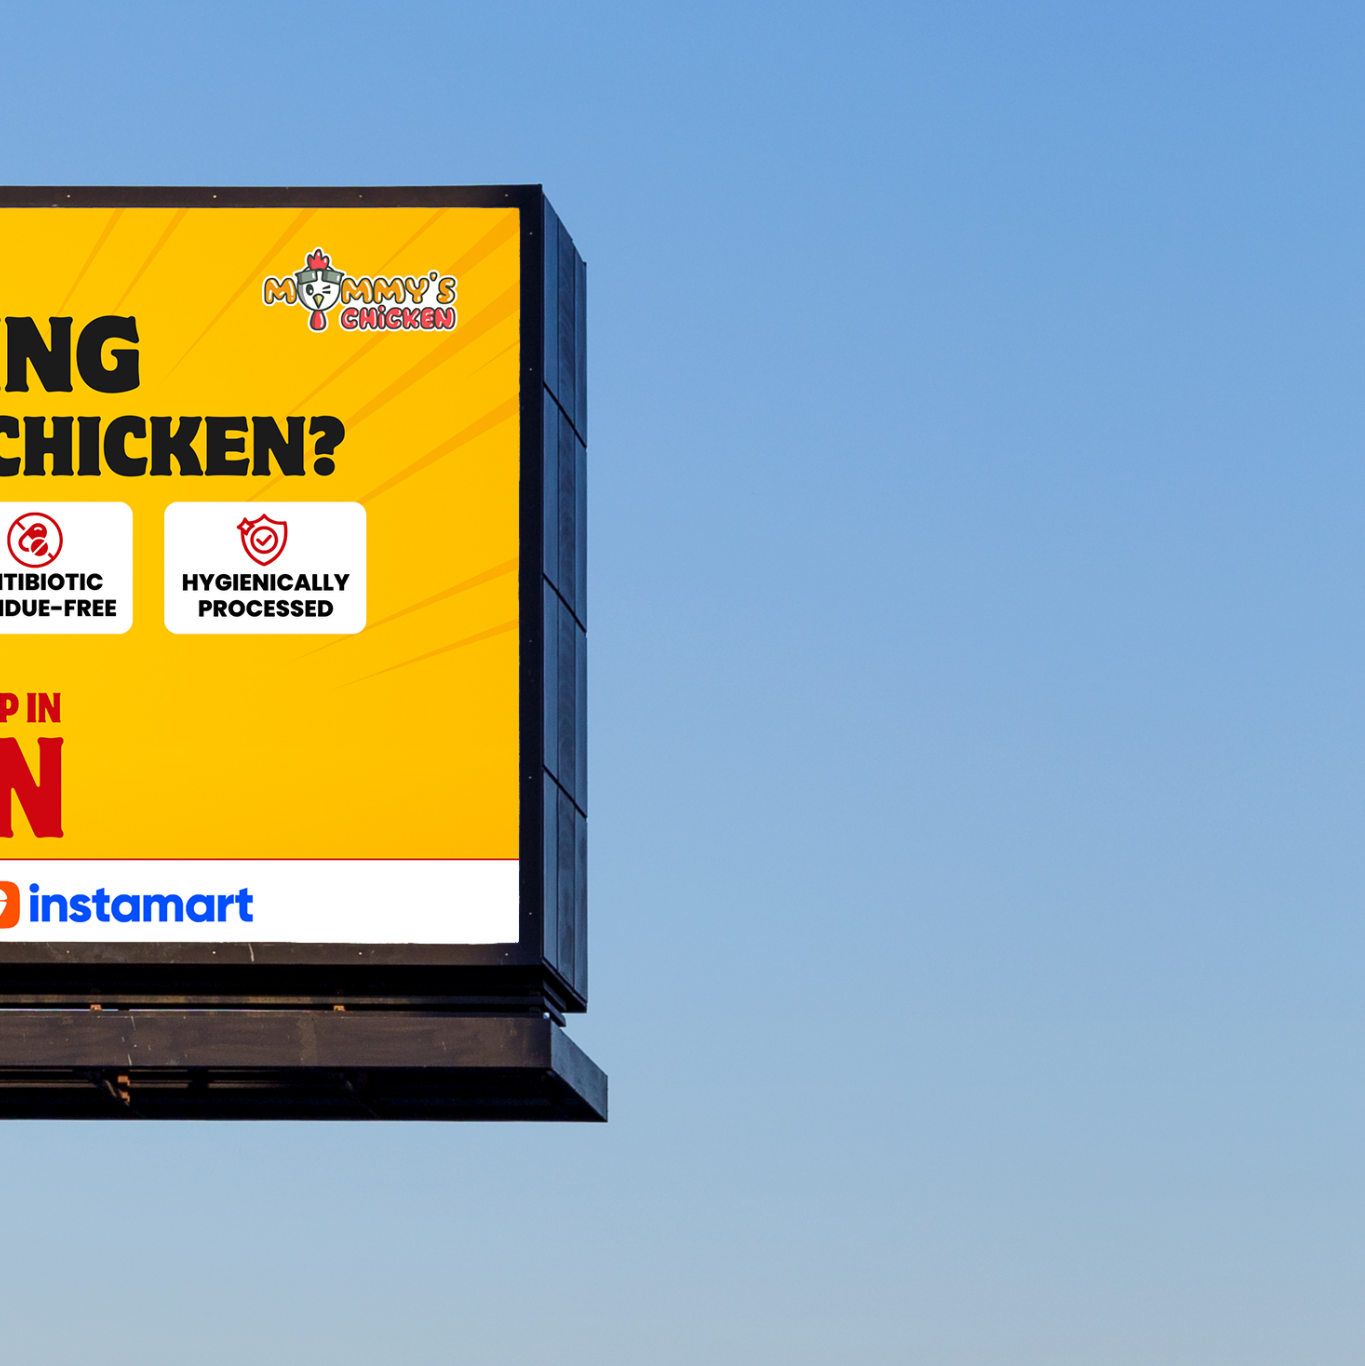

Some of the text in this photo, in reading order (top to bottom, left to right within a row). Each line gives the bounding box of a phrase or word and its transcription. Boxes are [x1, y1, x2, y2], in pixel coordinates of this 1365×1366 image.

[182, 573, 350, 592] HYGIENICALLY
[198, 600, 334, 618] PROCESSED
[26, 692, 61, 724] IN
[28, 881, 254, 923] instamart
